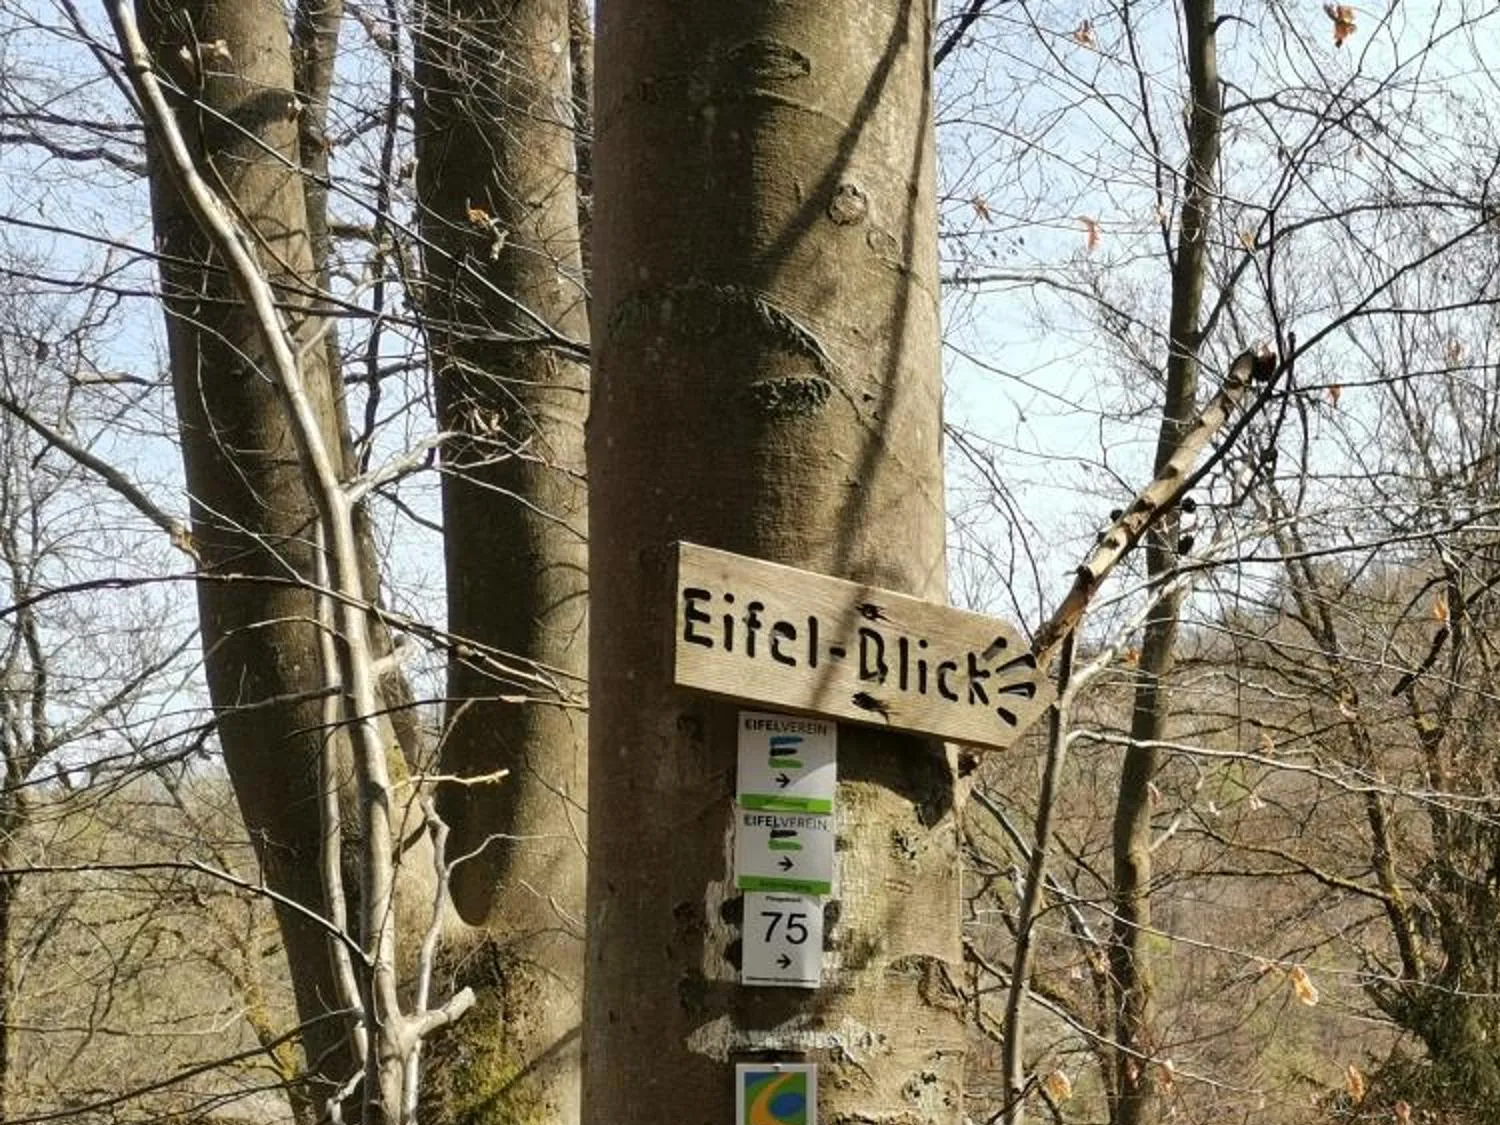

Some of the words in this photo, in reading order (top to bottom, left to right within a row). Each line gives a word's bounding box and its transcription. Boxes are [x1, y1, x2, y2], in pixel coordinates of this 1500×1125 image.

[683, 587, 991, 706] Eifel-Blick
[744, 719, 827, 735] EIFELVEREIN
[743, 814, 828, 830] EIFELVEREIN
[761, 911, 809, 945] 75
